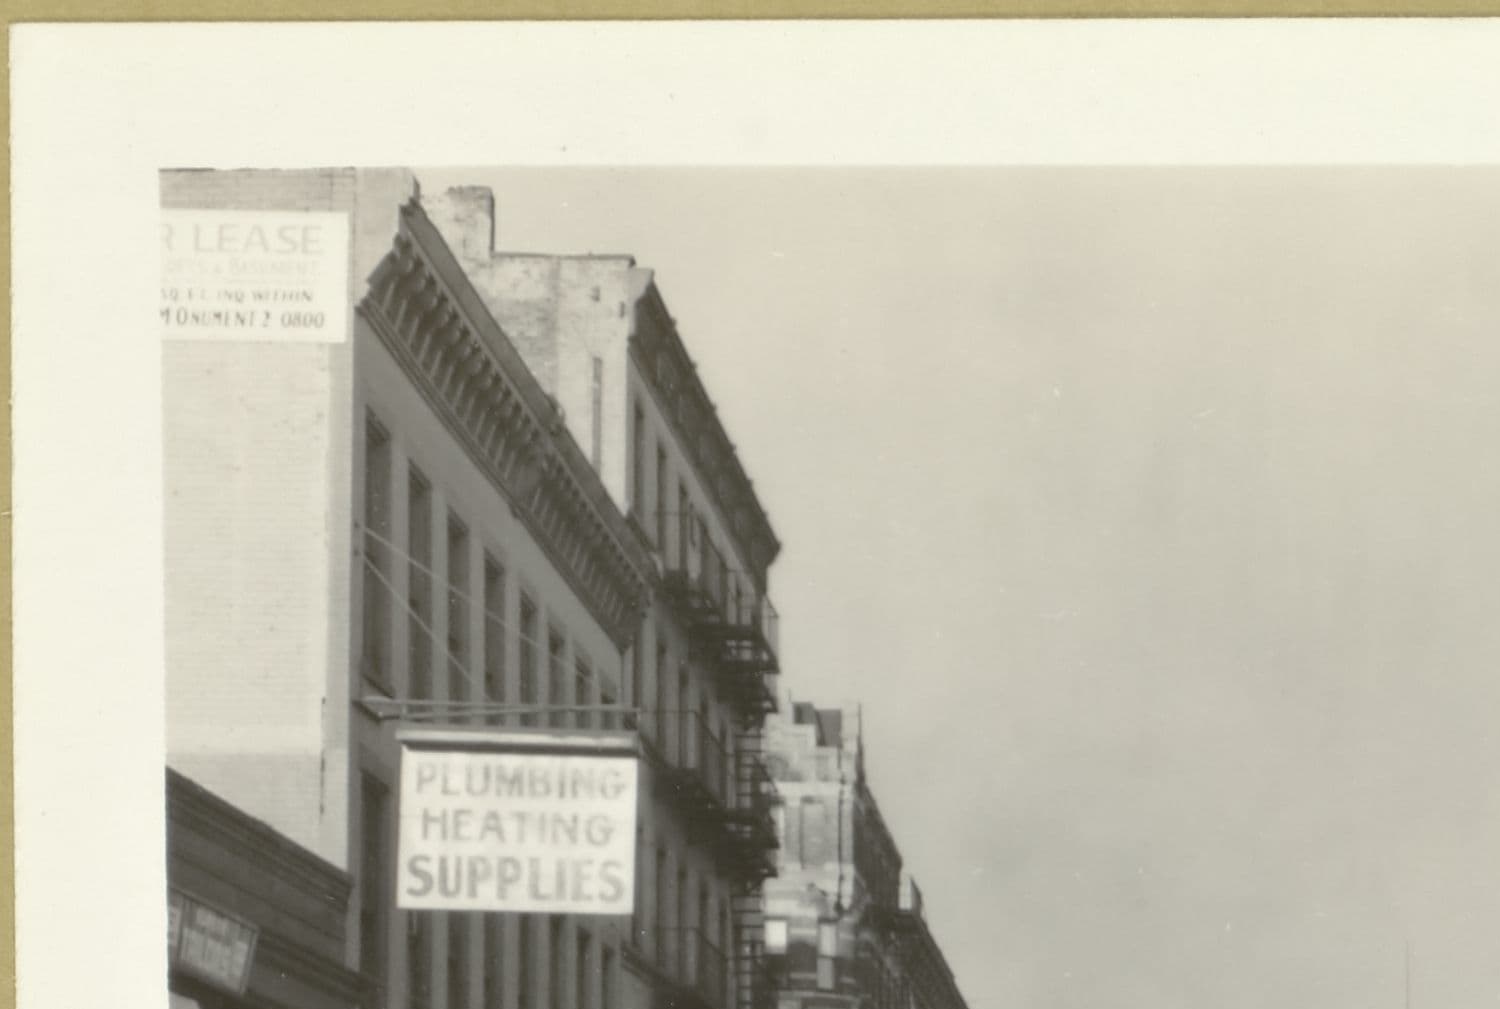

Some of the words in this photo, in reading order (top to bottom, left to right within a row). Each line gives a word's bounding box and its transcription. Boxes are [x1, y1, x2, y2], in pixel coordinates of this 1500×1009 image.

[193, 222, 324, 255] LEASE
[252, 287, 314, 302] WITHIN
[415, 762, 627, 800] PLUMBING
[421, 806, 616, 848] HEATING
[405, 854, 626, 904] SUPPLIES
